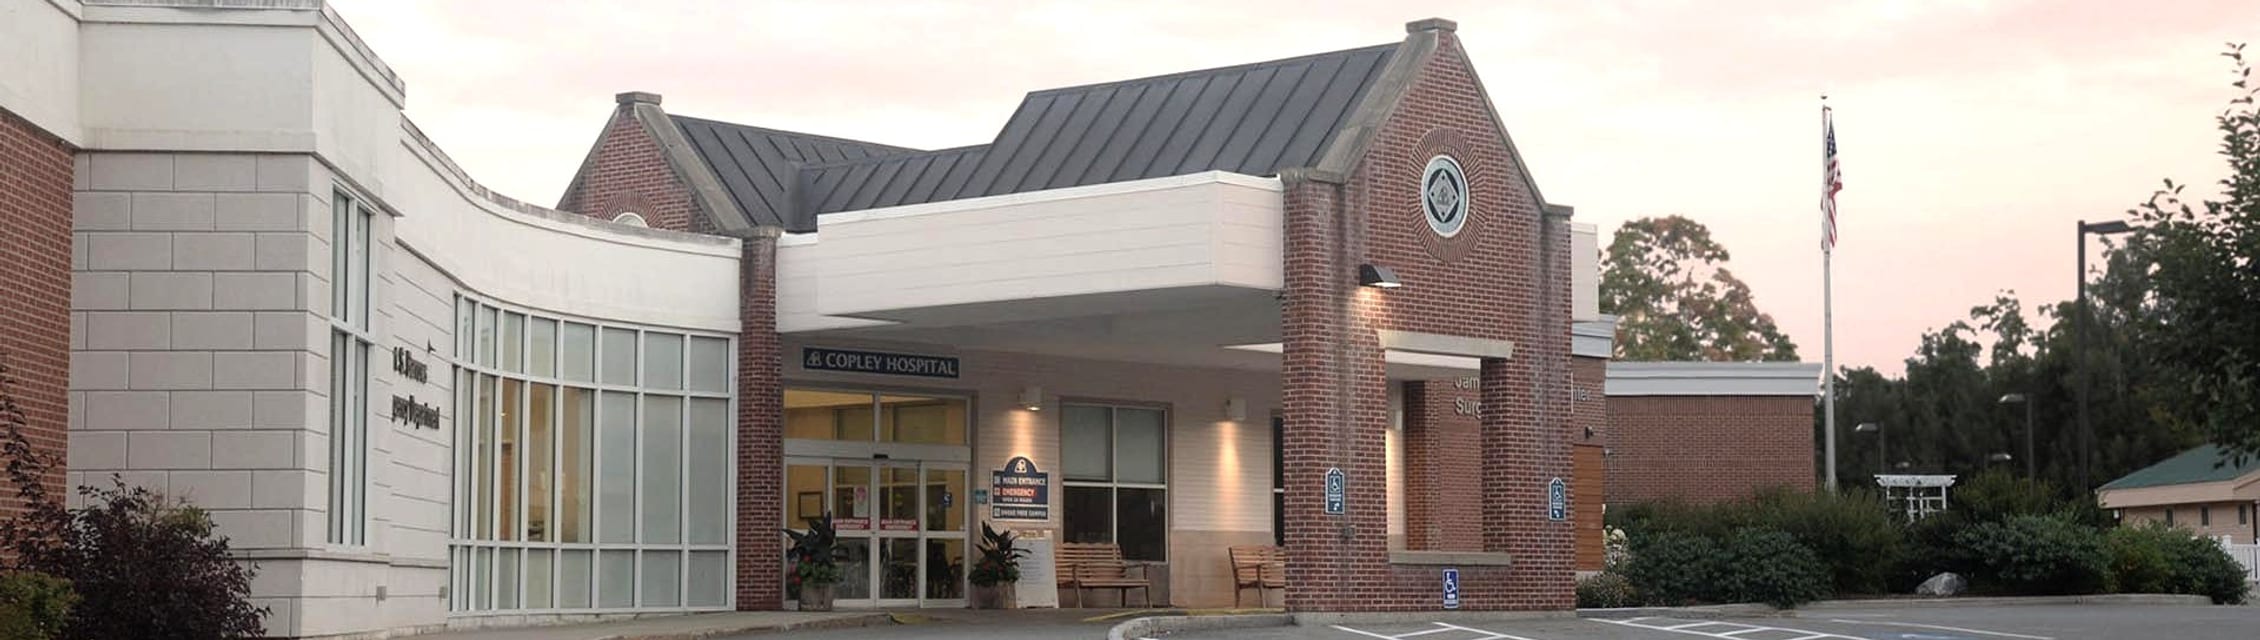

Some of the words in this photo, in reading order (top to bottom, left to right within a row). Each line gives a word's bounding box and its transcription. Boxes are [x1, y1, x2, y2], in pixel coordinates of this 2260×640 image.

[825, 352, 883, 370] COPLEY
[886, 357, 958, 375] HOSPITAL
[1002, 476, 1017, 485] MAIN
[1018, 477, 1047, 486] ENTRANCE
[1002, 488, 1035, 497] EMERGENCY
